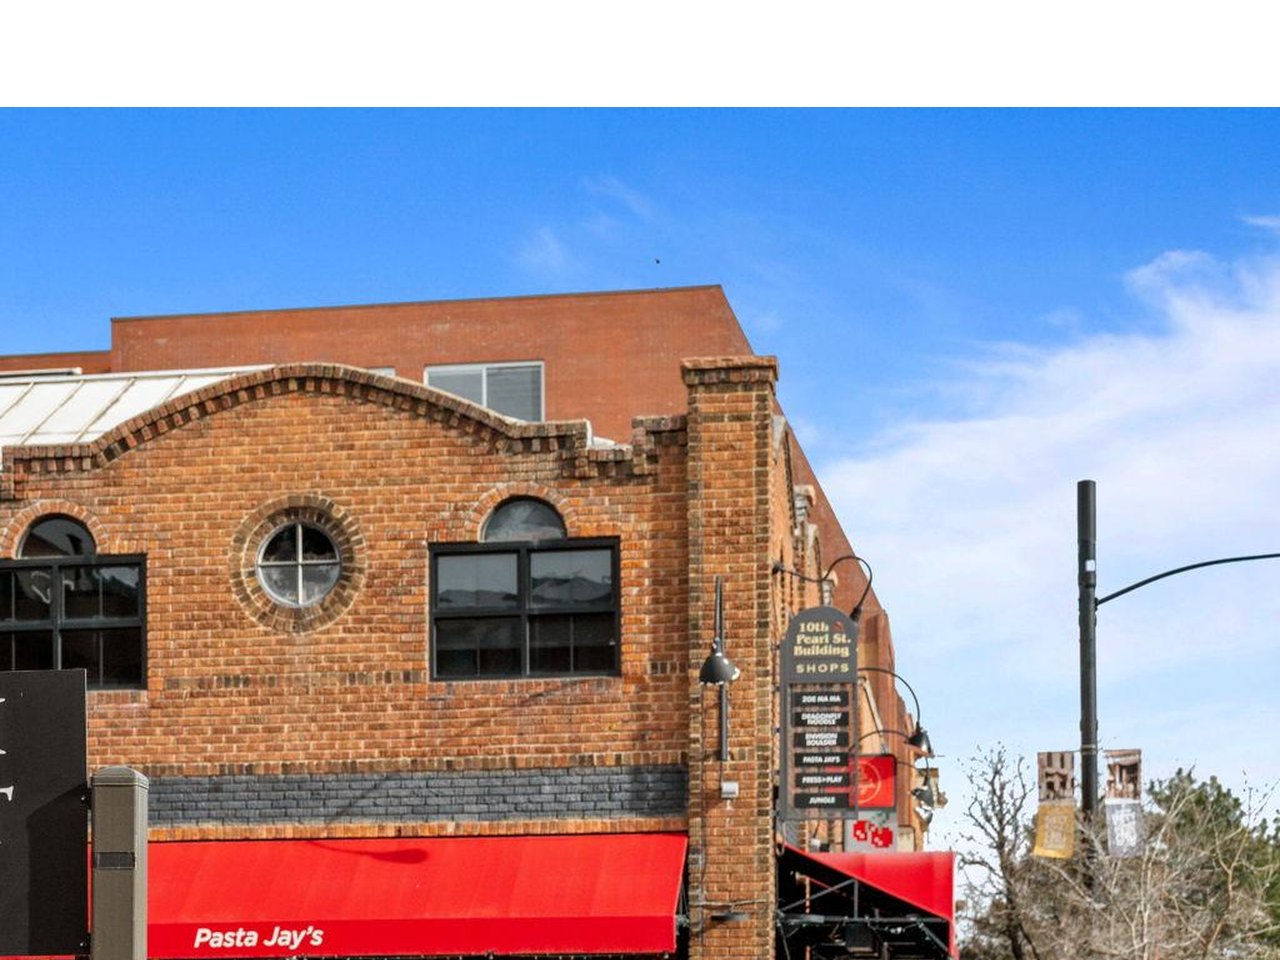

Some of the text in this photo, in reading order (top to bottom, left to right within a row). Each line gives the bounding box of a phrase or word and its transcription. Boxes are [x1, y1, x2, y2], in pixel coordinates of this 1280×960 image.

[799, 621, 829, 632] 10th
[796, 633, 851, 645] Pearl St.
[793, 645, 850, 658] Building
[796, 663, 849, 674] SHOPS
[193, 925, 324, 950] Pasta Jay's
